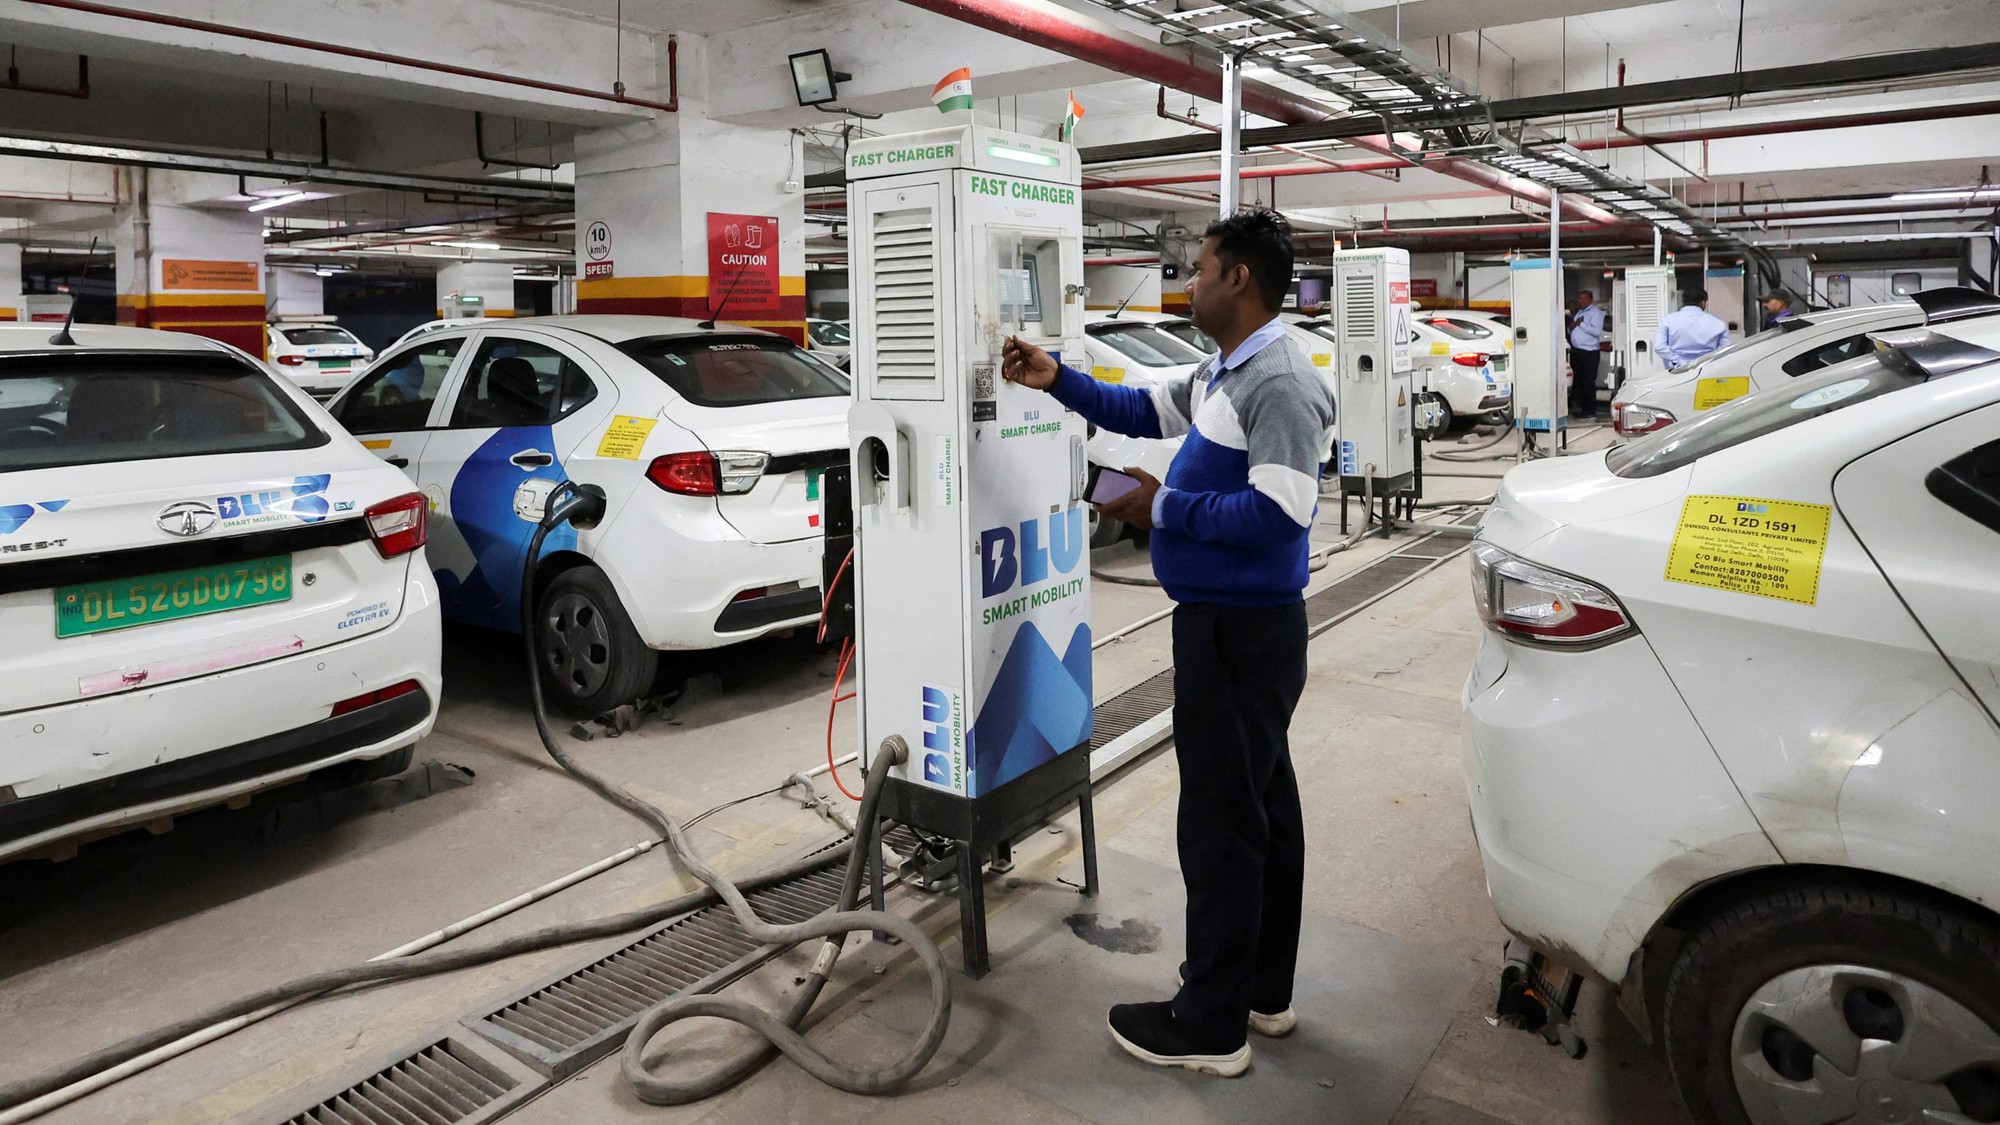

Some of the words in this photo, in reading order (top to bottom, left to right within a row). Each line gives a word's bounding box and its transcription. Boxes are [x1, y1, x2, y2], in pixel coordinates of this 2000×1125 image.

[851, 152, 883, 168] FAST
[887, 145, 954, 164] CHARGER
[971, 176, 1008, 197] FAST
[1012, 182, 1075, 205] CHARGER
[591, 227, 605, 242] 10
[590, 244, 607, 255] km/h
[721, 254, 767, 266] CAUTION
[1352, 254, 1384, 262] CHARGER
[586, 264, 612, 276] SPEED
[1024, 410, 1040, 421] BLU
[1001, 426, 1028, 439] SMART
[1030, 421, 1062, 436] CHARGE
[1343, 441, 1356, 474] BLU
[1737, 502, 1768, 514] BLU
[223, 518, 251, 528] SMART
[252, 514, 289, 523] MOBILITY
[1708, 514, 1727, 525] DL
[1732, 517, 1759, 528] 1ZD
[1764, 520, 1797, 533] 1591
[1684, 523, 1710, 531] GENSOL
[1711, 526, 1759, 537] CONSULTANTS
[1761, 532, 1789, 541] PRIVATE
[1790, 537, 1818, 545] LIMITED
[981, 507, 1082, 599] BLU
[1695, 552, 1711, 561] C/O
[1713, 555, 1726, 563] Blu
[1729, 558, 1753, 568] Smart
[1755, 562, 1789, 574] Mobility
[1690, 569, 1715, 578] Women
[1717, 573, 1748, 583] Helpline
[1771, 581, 1789, 590] 1091
[1720, 579, 1742, 589] Police
[83, 566, 288, 624] DL52GD0798
[983, 597, 1028, 625] SMART
[1031, 577, 1084, 609] MOBILITY
[337, 612, 377, 630] ELECTRA
[379, 609, 389, 618] EV
[347, 604, 378, 617] POWERED
[379, 601, 388, 609] BY
[953, 693, 961, 747] MOBILITY
[922, 686, 951, 788] BLU
[954, 750, 962, 790] SMART
